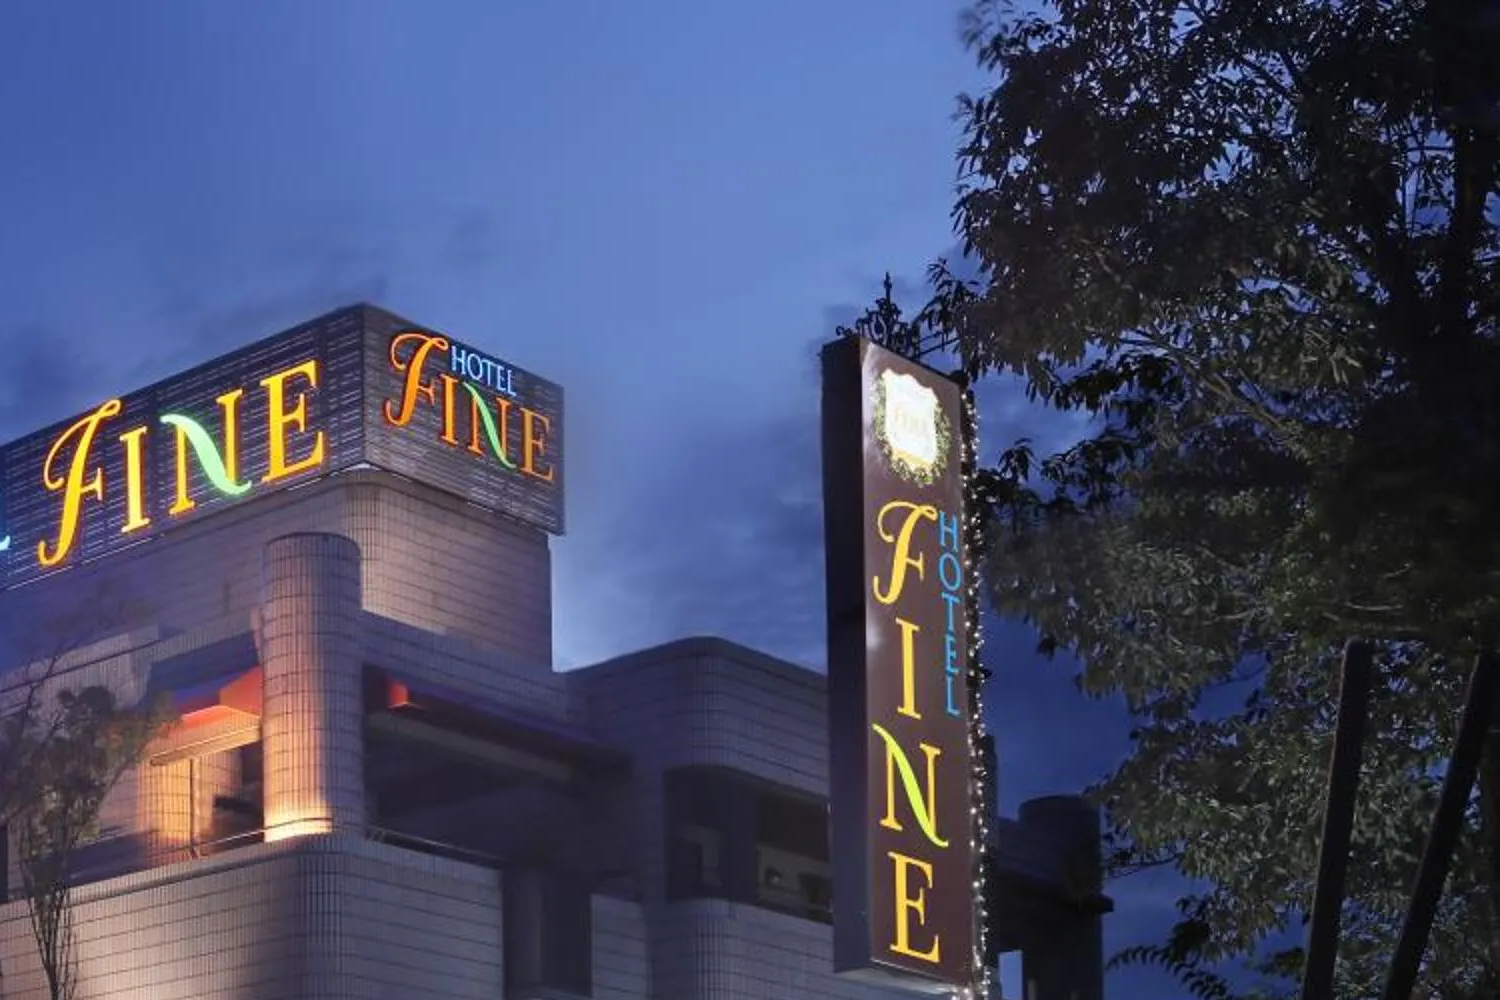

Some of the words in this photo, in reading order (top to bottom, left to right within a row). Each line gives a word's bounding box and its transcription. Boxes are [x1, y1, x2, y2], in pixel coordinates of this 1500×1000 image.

[37, 359, 328, 568] FINE
[385, 332, 556, 483] FINE
[451, 344, 518, 398] HOTEL
[938, 511, 964, 718] HOTEL
[872, 500, 949, 964] FINE
